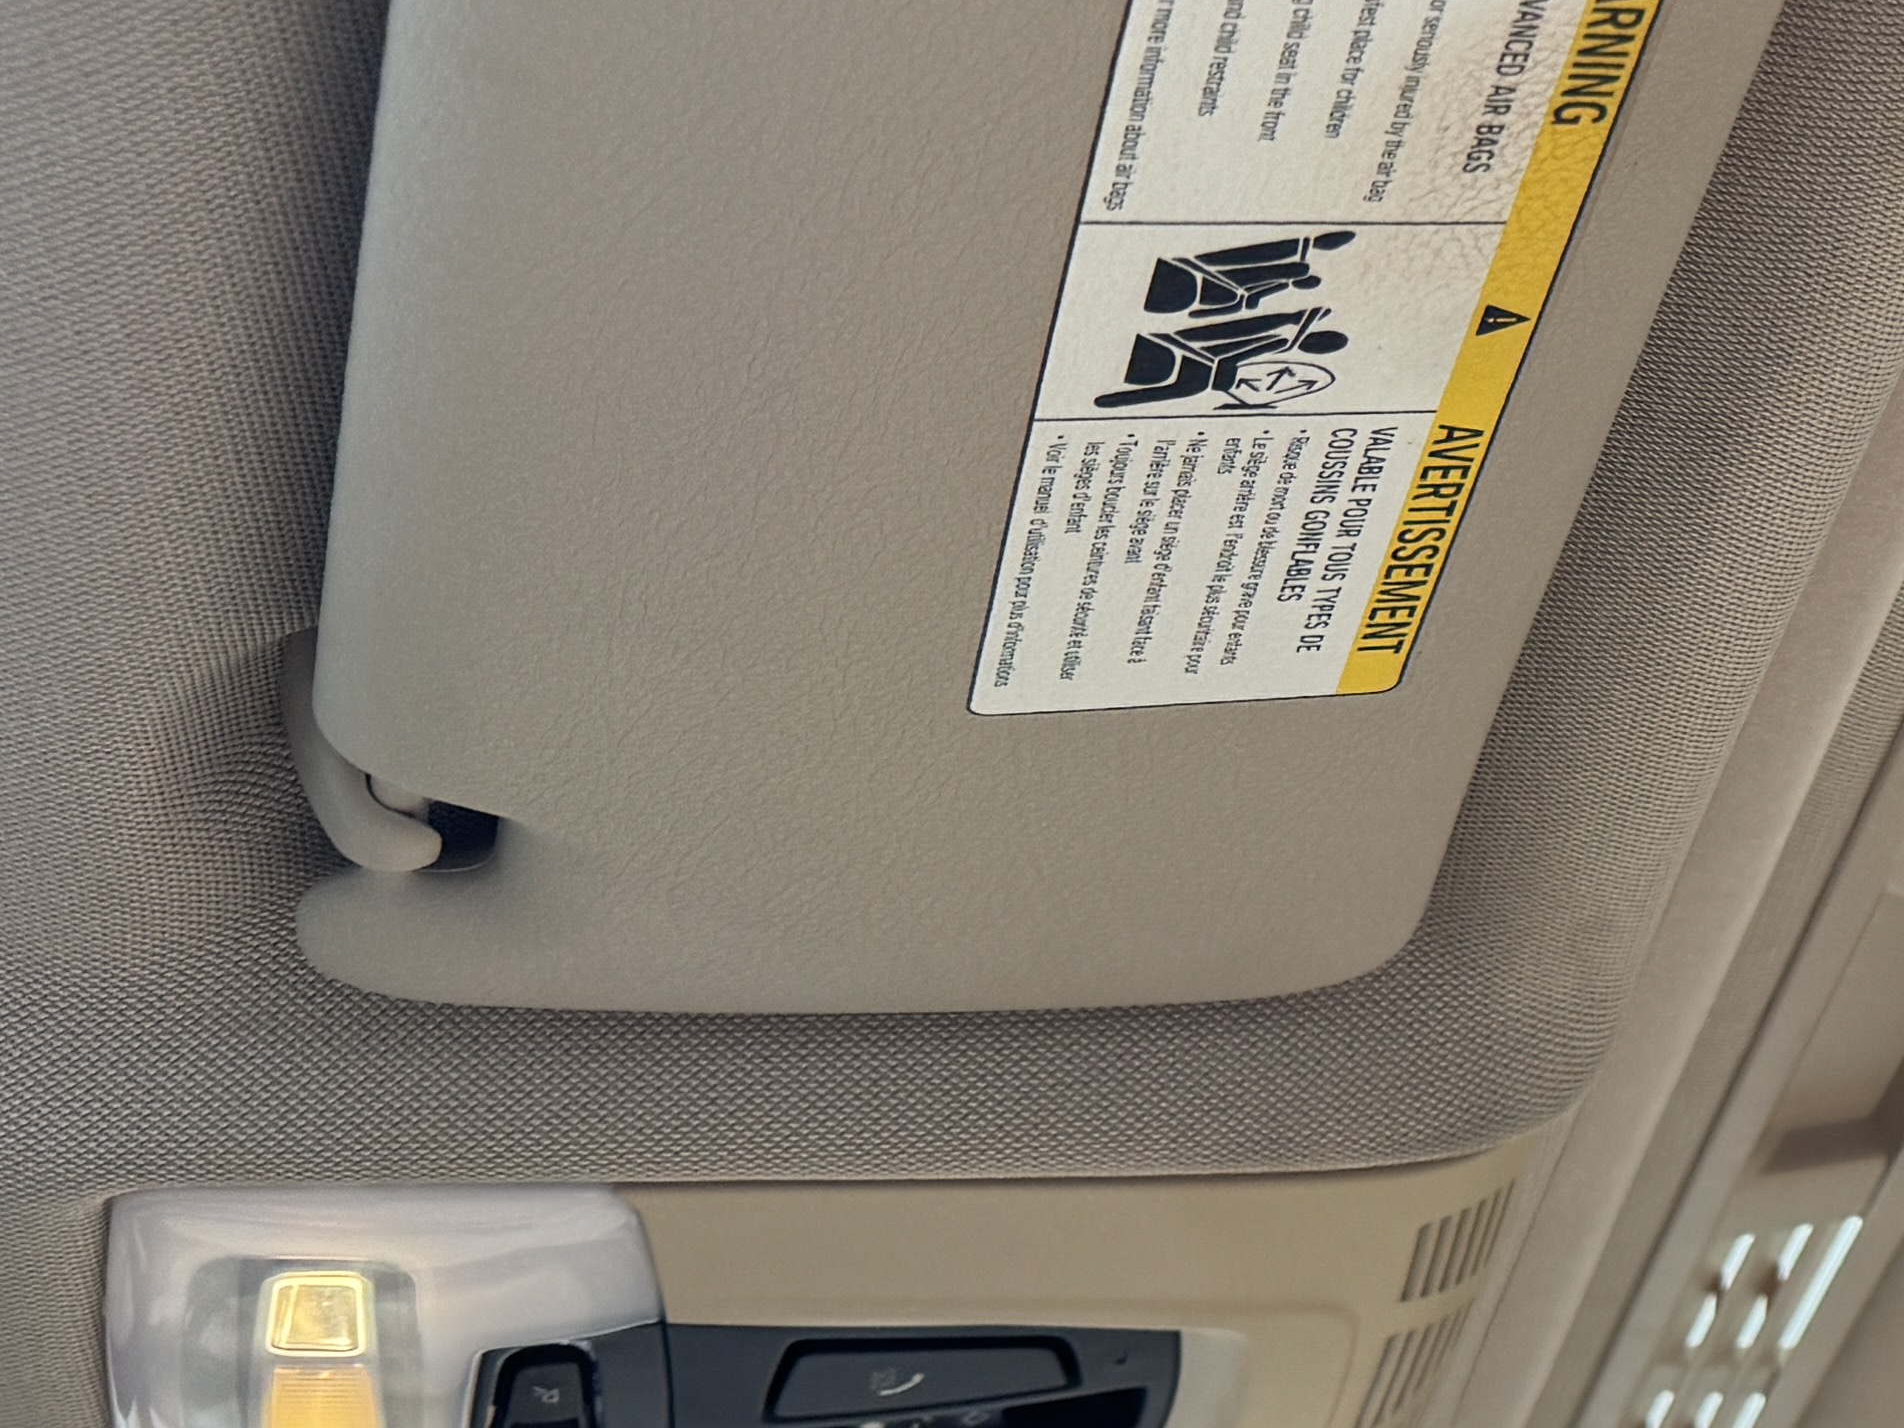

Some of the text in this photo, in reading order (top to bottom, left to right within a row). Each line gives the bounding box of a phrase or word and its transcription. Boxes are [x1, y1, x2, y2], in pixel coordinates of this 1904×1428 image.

[1147, 7, 1173, 44] more
[1213, 21, 1239, 54] child
[1286, 7, 1313, 40] child
[1278, 41, 1301, 70] seat
[1345, 29, 1373, 65] place
[1404, 16, 1441, 74] seriously
[1129, 46, 1165, 122] information
[1197, 56, 1228, 117] restraints
[1340, 66, 1365, 86] for
[1267, 86, 1292, 109] the
[1325, 88, 1355, 139] children
[1393, 75, 1421, 119] injured
[1480, 86, 1518, 116] AIR
[1118, 124, 1146, 161] about
[1257, 110, 1286, 142] front
[1381, 139, 1405, 160] the
[1459, 124, 1504, 174] BAGS
[1102, 181, 1133, 211] bags
[1362, 179, 1393, 203] bag
[1045, 442, 1068, 463] Voir
[1107, 440, 1139, 485] Toujours
[1033, 476, 1055, 514] manuel
[1168, 489, 1192, 519] placer
[1277, 428, 1358, 602] COUSSINS GONFLABLES
[1124, 537, 1145, 564] avant
[1296, 427, 1398, 653] VALABLE POUR TOUS TYPES DE
[1357, 426, 1481, 652] AVERTISSEMENT
[1008, 600, 1029, 620] plus
[1204, 584, 1227, 604] plus
[1231, 609, 1250, 631] pour
[1129, 636, 1153, 657] face
